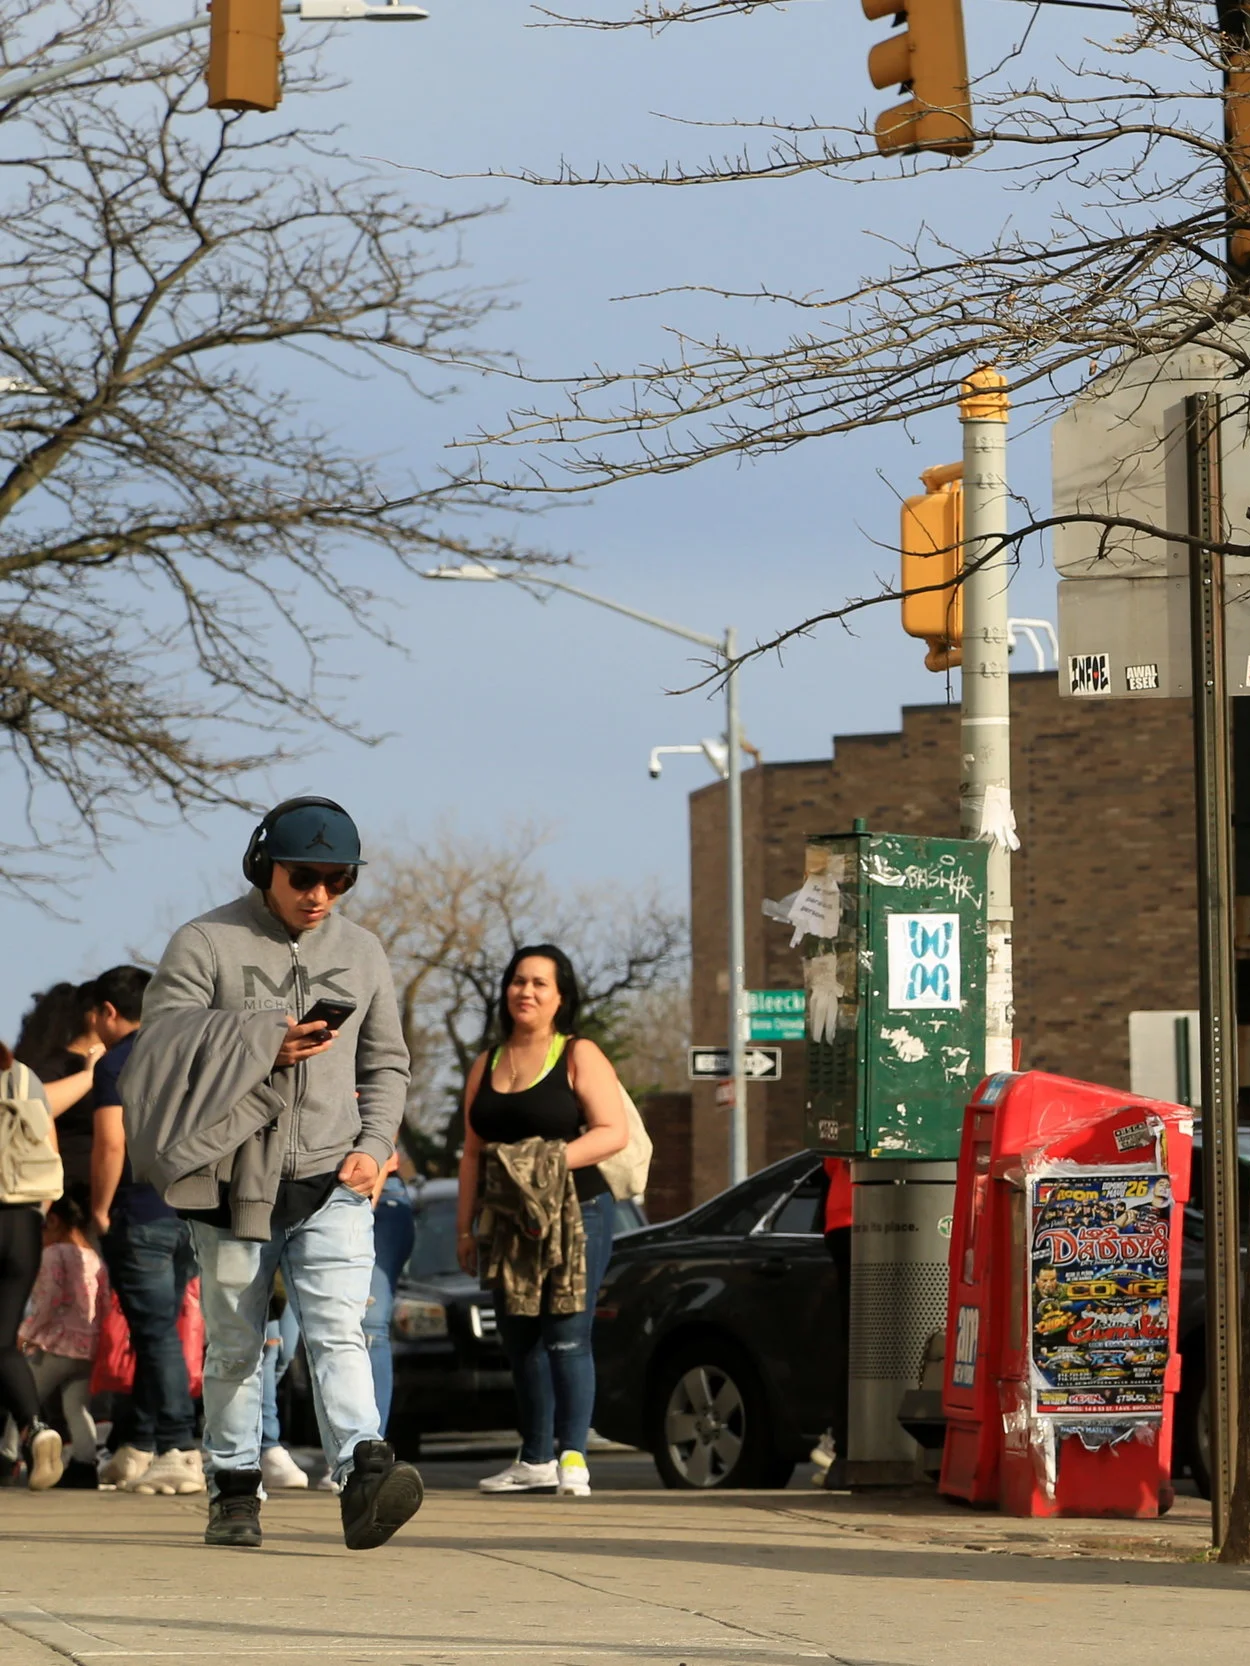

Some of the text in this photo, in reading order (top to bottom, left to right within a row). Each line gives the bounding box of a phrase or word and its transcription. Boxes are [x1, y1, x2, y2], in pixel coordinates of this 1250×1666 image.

[1126, 665, 1158, 680] AWAL
[1129, 677, 1157, 690] ESEK
[242, 965, 357, 998] MK
[1125, 1181, 1148, 1197] 26
